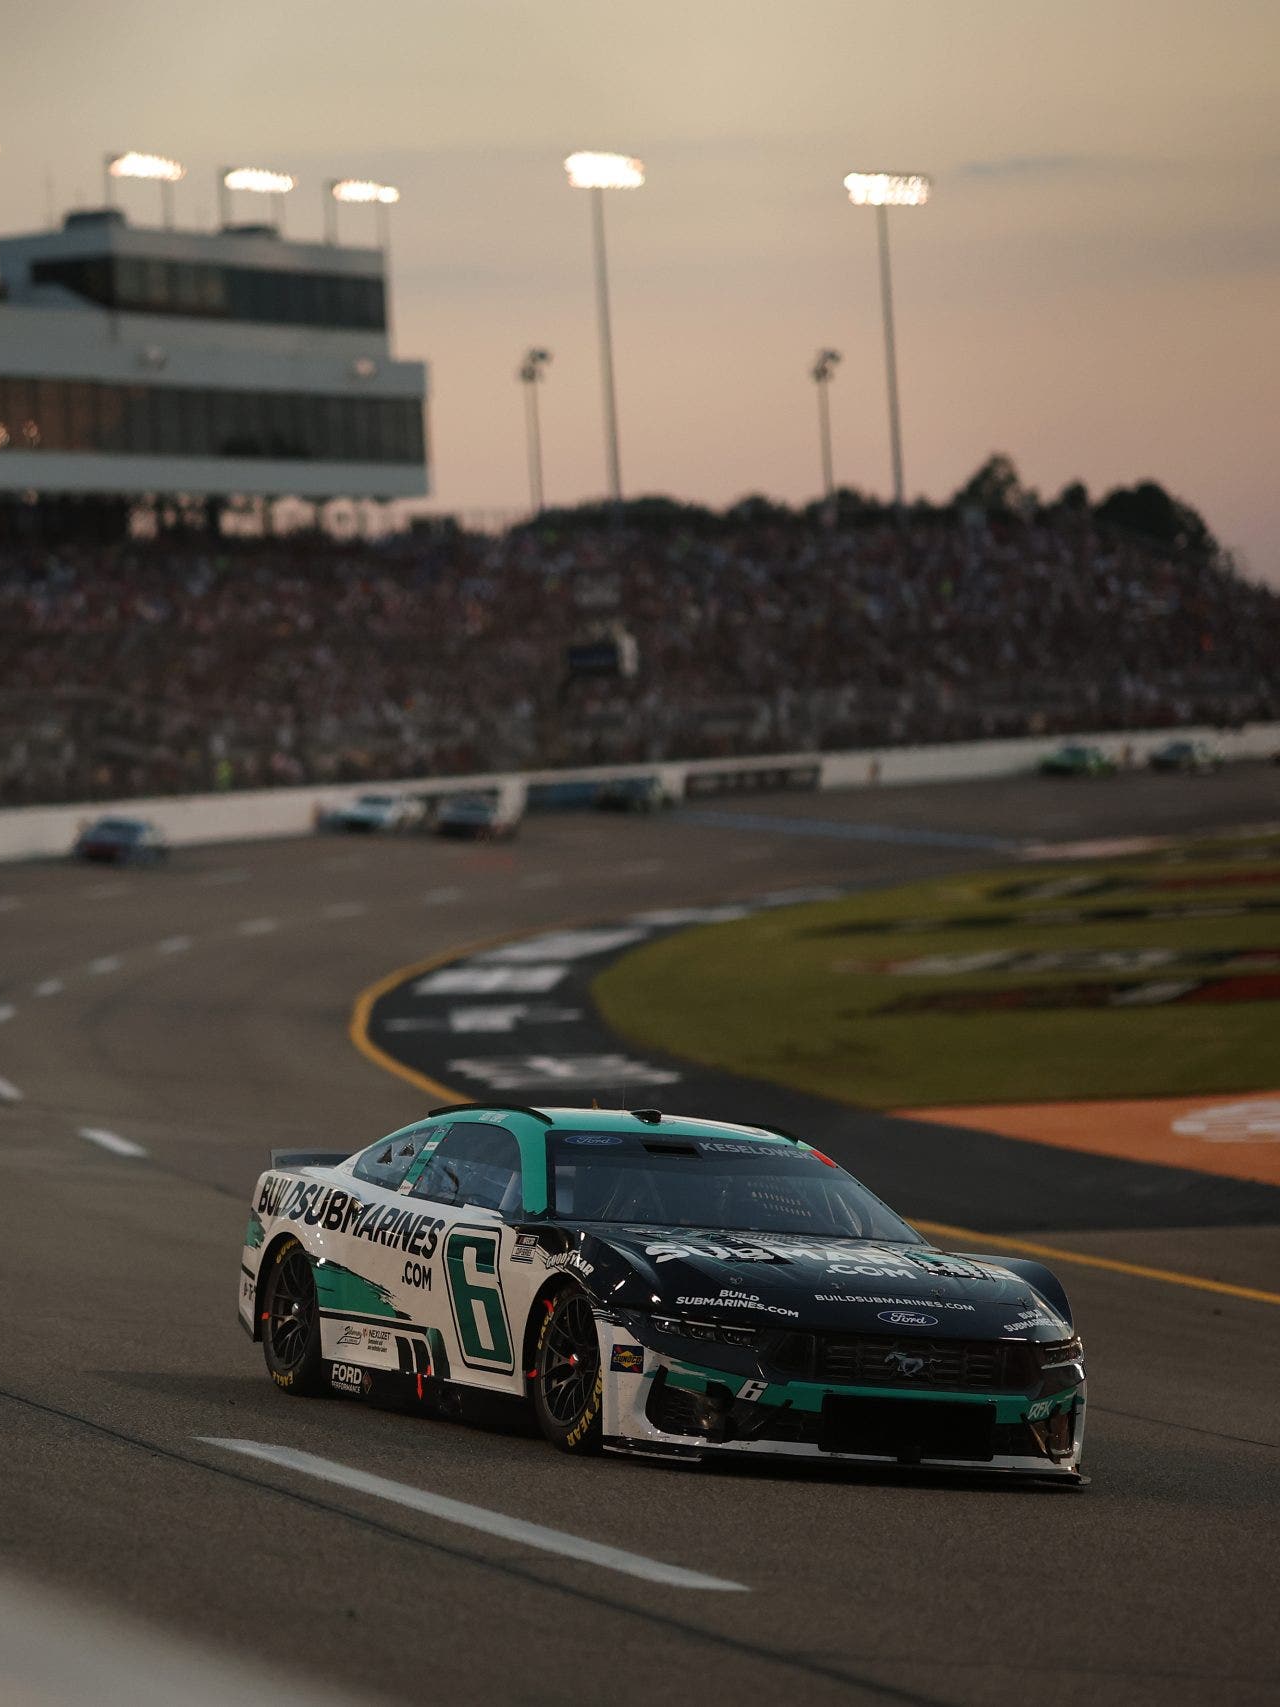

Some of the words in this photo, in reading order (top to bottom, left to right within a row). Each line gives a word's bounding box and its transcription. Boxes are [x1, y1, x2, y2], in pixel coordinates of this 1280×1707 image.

[258, 1175, 446, 1260] BUILDSUBMARINES
[401, 1260, 432, 1291] .COM
[825, 1264, 917, 1280] .COM
[446, 1233, 513, 1365] 6
[719, 1289, 760, 1301] BUILD
[814, 1294, 976, 1312] BUILDSUBMARINES.COM
[676, 1296, 799, 1318] SUBMARINES.COM
[889, 1311, 927, 1325] Ford
[332, 1363, 362, 1384] FORD
[736, 1379, 767, 1402] 6
[1027, 1399, 1054, 1420] RFK
